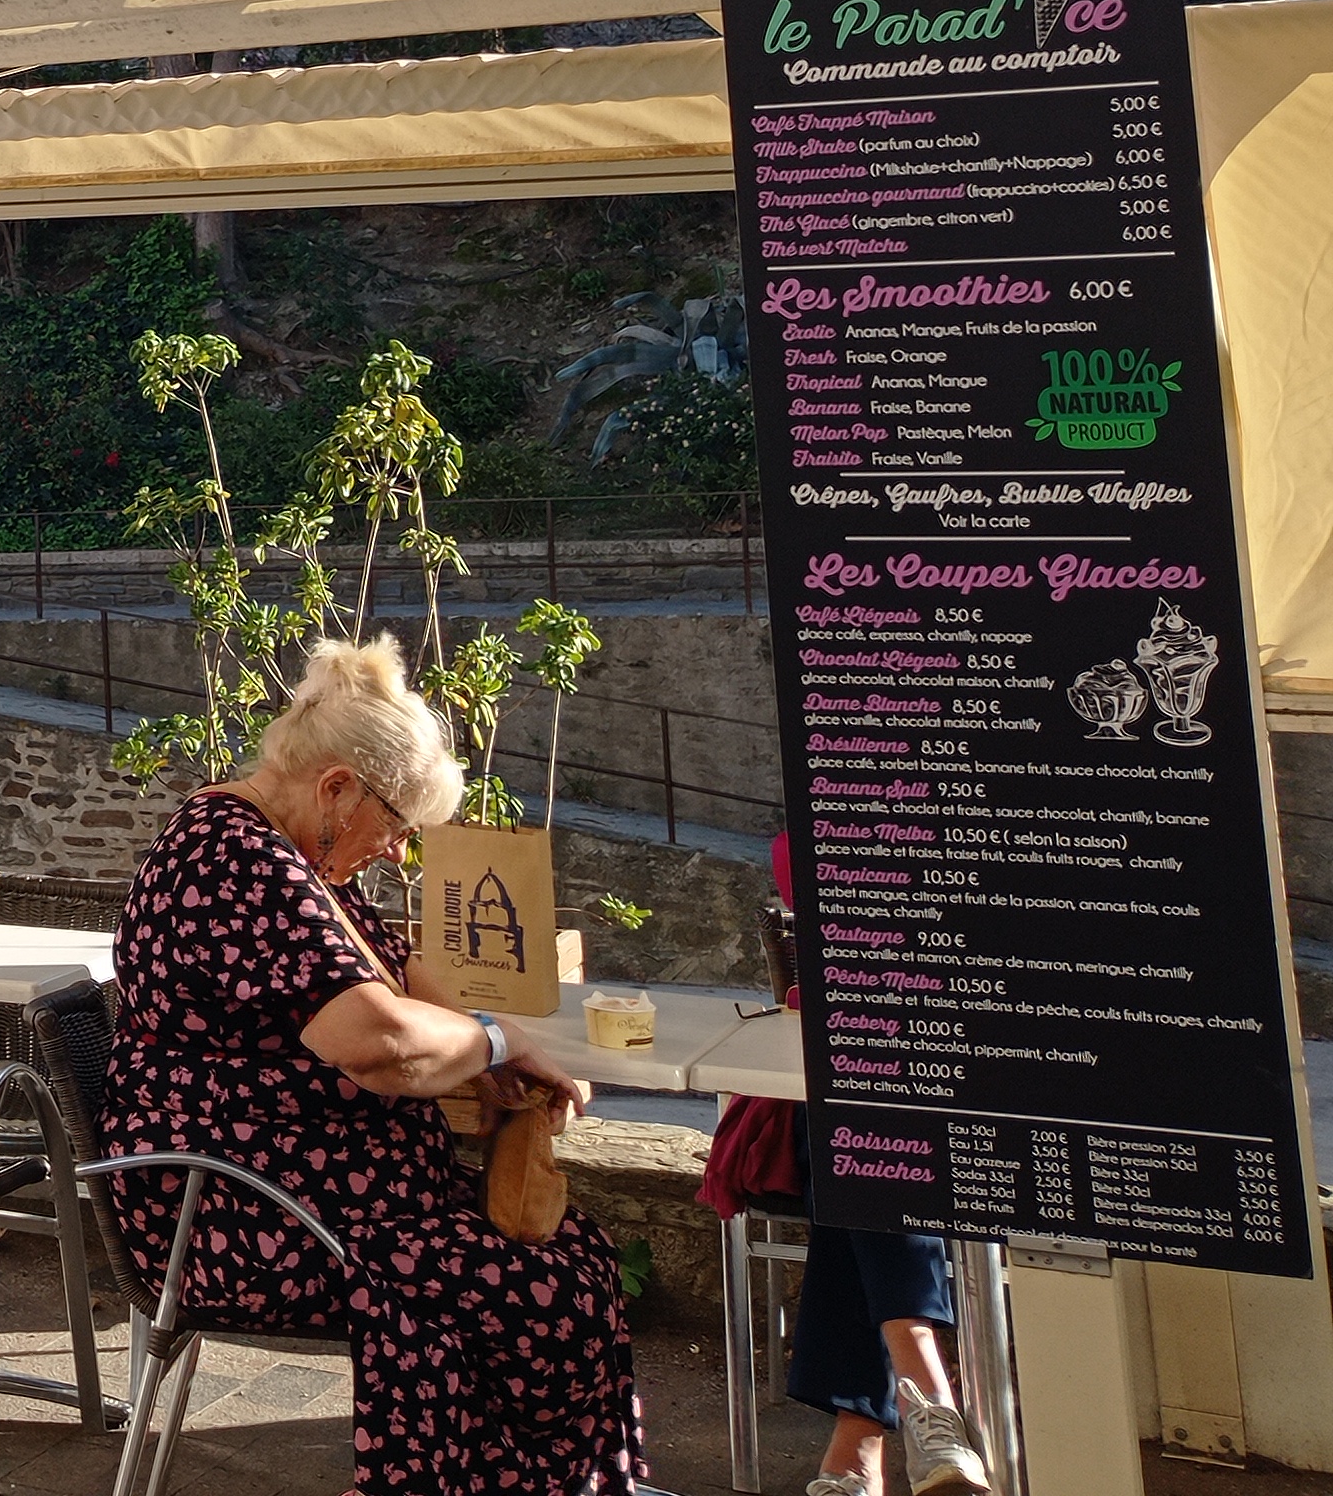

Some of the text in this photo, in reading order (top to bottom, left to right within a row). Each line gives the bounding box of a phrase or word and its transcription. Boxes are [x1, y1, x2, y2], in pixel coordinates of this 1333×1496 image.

[783, 41, 1121, 85] Commande au comptoir
[751, 115, 796, 136] Café
[797, 112, 864, 131] Frappé
[865, 109, 936, 128] Maison
[753, 141, 798, 160] Milk
[799, 138, 857, 158] Shake
[914, 139, 933, 148] au
[936, 132, 979, 147] choix)
[756, 163, 868, 183] Frappuccino
[758, 188, 870, 208] Frappuccino
[871, 183, 965, 207] gourmand
[760, 215, 795, 232] Thé
[796, 214, 850, 236] Glacé
[937, 212, 977, 224] citron
[979, 208, 1013, 222] vert)
[762, 241, 797, 257] Thé
[798, 240, 835, 255] vert
[835, 238, 908, 257] Matcha
[761, 278, 836, 319] Les
[842, 274, 1050, 317] Smoothies
[782, 323, 836, 341] Exotic
[965, 321, 999, 334] Fruits
[1002, 320, 1022, 334] de
[1025, 320, 1040, 333] la
[1042, 320, 1097, 335] passion
[784, 349, 837, 366] Fresh
[890, 349, 947, 363] Orange
[1041, 348, 1165, 384] 100%
[786, 373, 862, 392] Tropical
[928, 374, 987, 388] Mangue
[788, 398, 861, 415] Banana
[915, 400, 971, 413] Banane
[1049, 390, 1161, 415] NATURAL
[790, 425, 850, 443] Melon
[851, 423, 888, 442] Pop
[967, 424, 1012, 438] Melon
[1068, 422, 1145, 441] PRODUCT
[916, 451, 962, 464] Vanille
[1087, 481, 1192, 509] Waffles
[938, 513, 1030, 527] Voir la carte
[804, 553, 1205, 606] Les Coupes Glacées
[795, 605, 841, 627] Café
[841, 605, 920, 628] Liégeois
[799, 649, 960, 672] Chocolat Liégeois
[802, 692, 941, 712] Dame Blanche
[805, 733, 909, 752] Brésilienne
[809, 776, 884, 795] Banana
[885, 779, 929, 798] Split
[813, 820, 872, 838] Fraise
[873, 823, 935, 843] Melba
[1014, 831, 1052, 845] selon
[1055, 832, 1070, 846] la
[1073, 834, 1127, 850] saison)
[816, 863, 911, 884] Tropicana
[444, 879, 462, 952] COLLIOURE
[824, 966, 943, 991] Pêche Melba
[826, 1011, 900, 1036] Iceberg
[830, 1054, 900, 1075] Colonel
[832, 1077, 870, 1090] sorbet
[912, 1081, 953, 1096] Vodka
[830, 1126, 932, 1154] Boissons
[947, 1122, 969, 1134] Eau
[971, 1124, 996, 1137] 50cl
[833, 1154, 934, 1182] Fraiches
